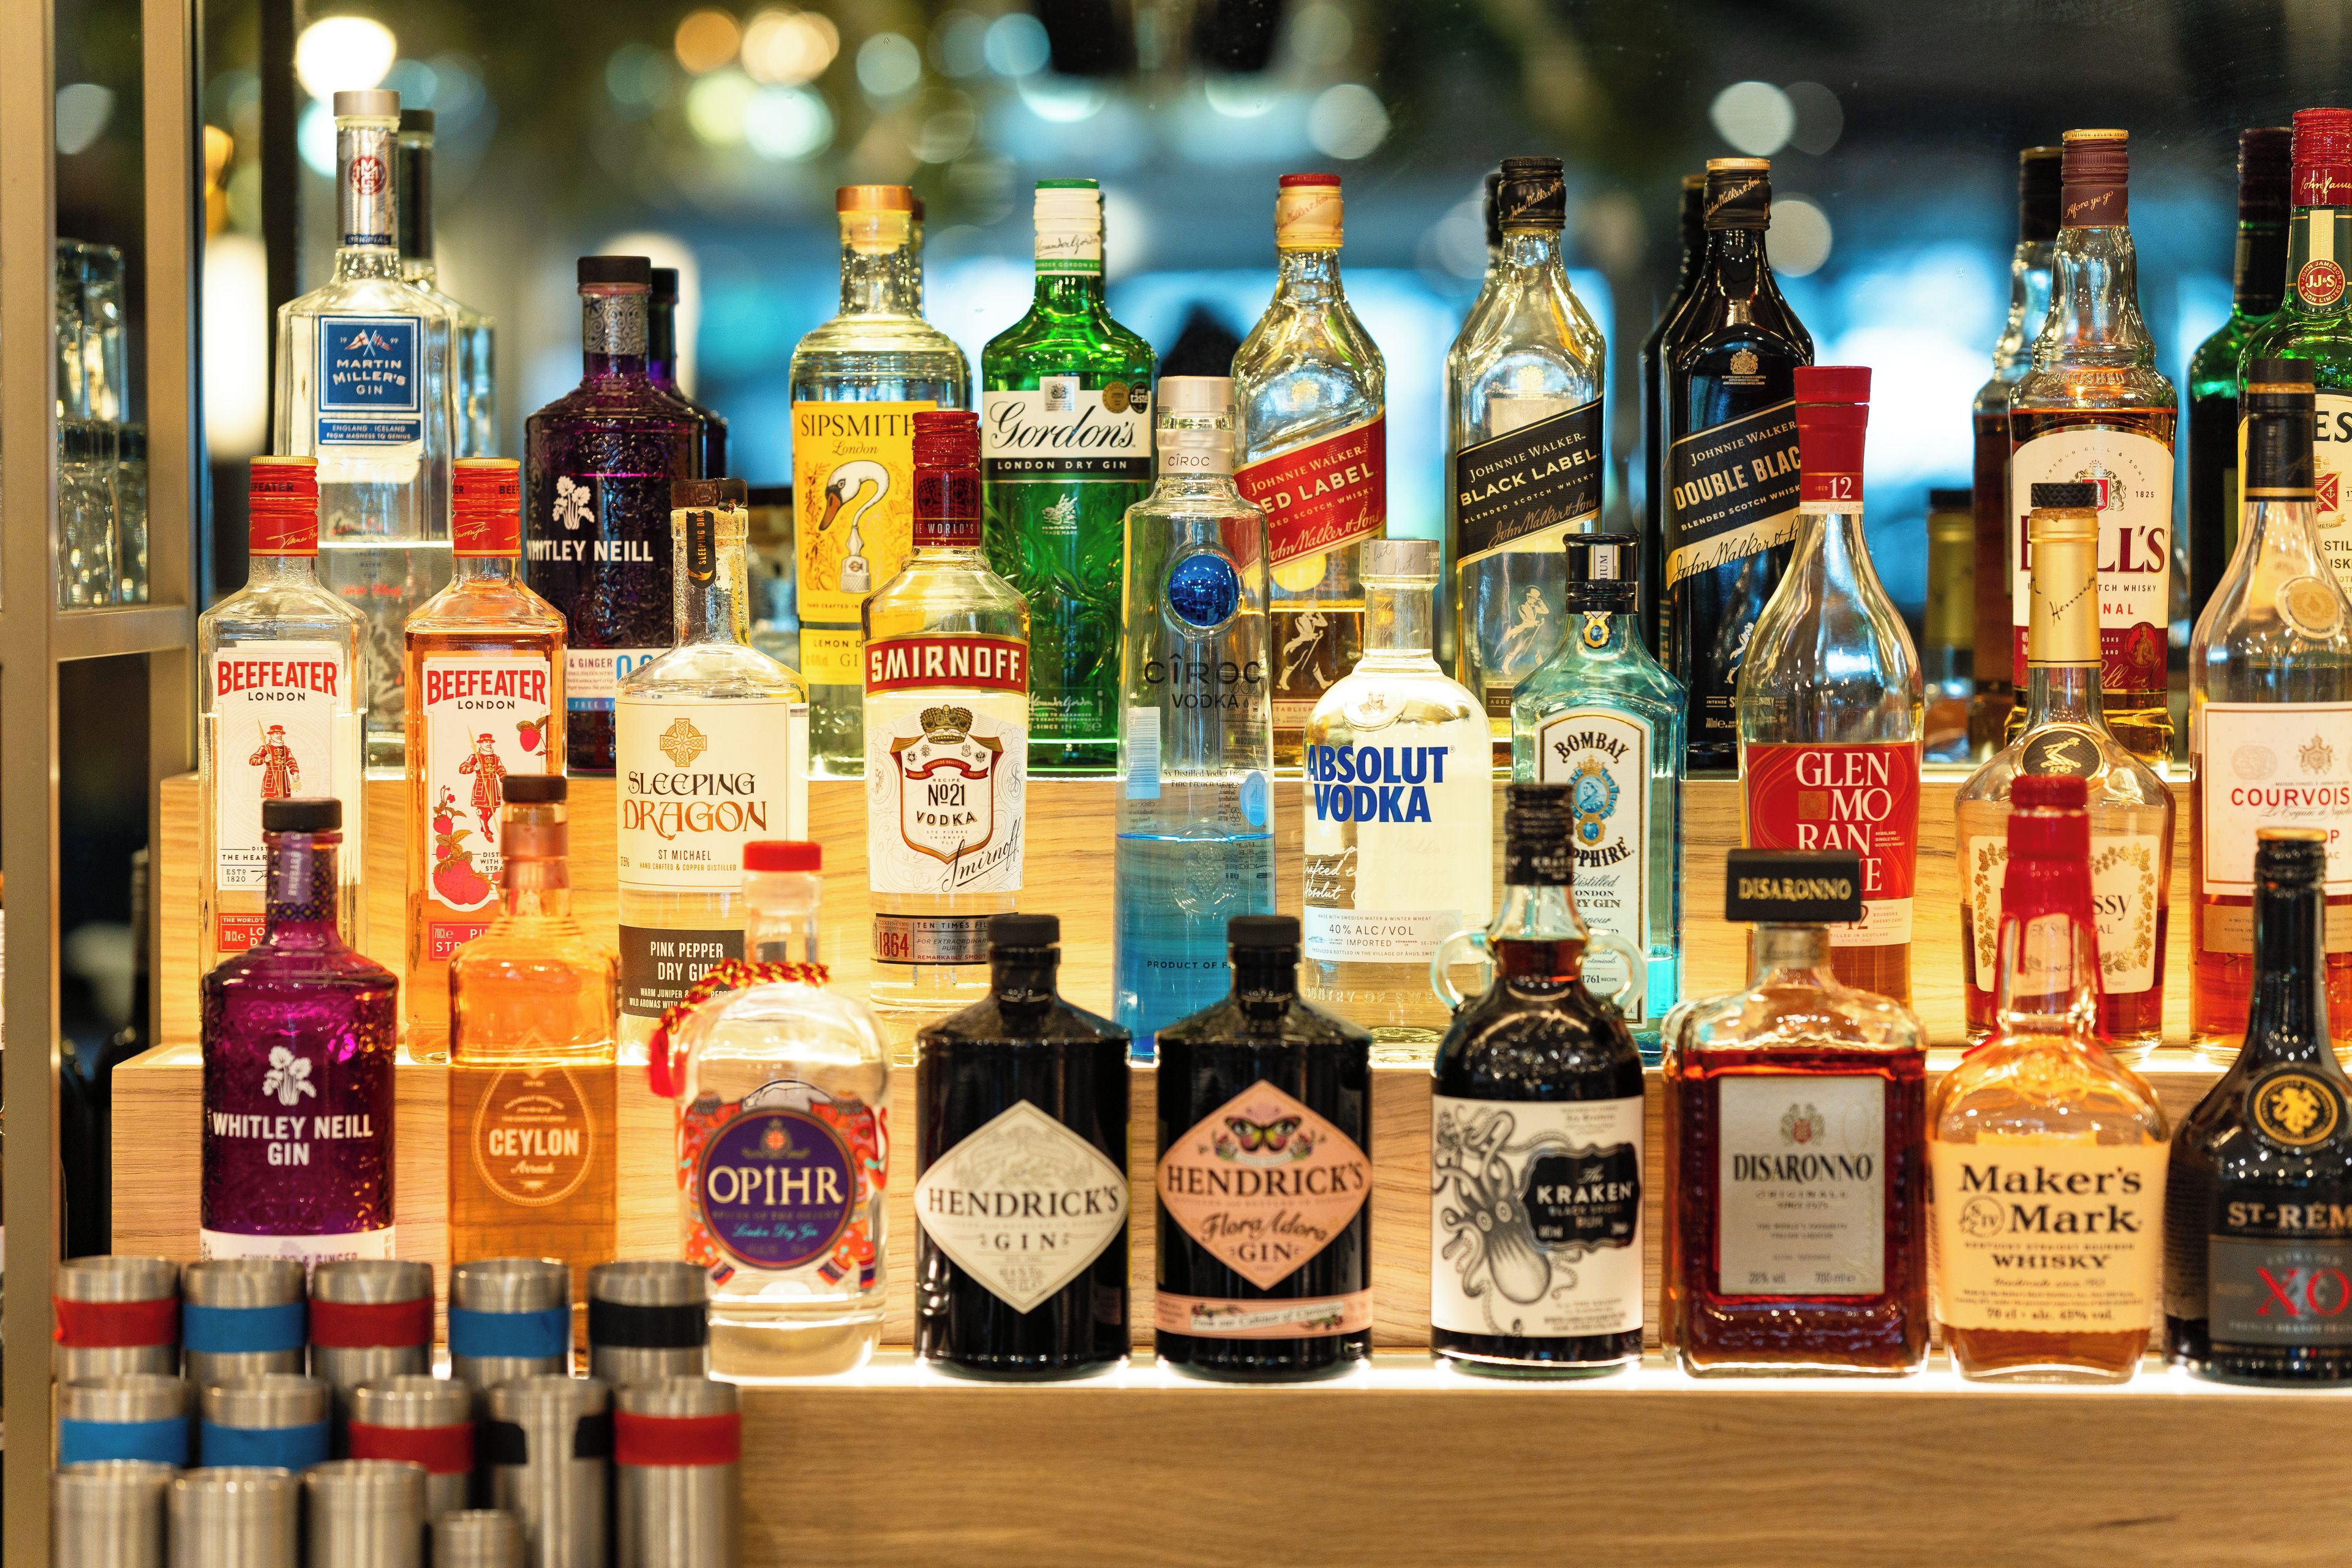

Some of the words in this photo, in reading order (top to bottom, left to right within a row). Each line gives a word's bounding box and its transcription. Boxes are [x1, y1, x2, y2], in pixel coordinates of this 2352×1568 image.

[1717, 186, 1744, 207] Walker
[2300, 176, 2323, 196] John
[2064, 199, 2089, 219] Afore
[2090, 195, 2101, 210] ye
[2103, 190, 2113, 206] go
[2301, 264, 2313, 281] JOHN
[2305, 274, 2335, 288] JJ&S
[2315, 261, 2342, 280] JAMESON
[2304, 292, 2316, 302] SON
[2319, 285, 2342, 303] LIMITED
[337, 359, 402, 369] MARTIN
[333, 371, 406, 386] MILLER'S
[356, 384, 383, 395] GIN
[990, 401, 1135, 449] Gordon's
[832, 439, 880, 456] London
[1690, 437, 1745, 467] JOHNNIE
[1745, 420, 1797, 445] WALKER
[997, 461, 1055, 470] LONDON
[1065, 461, 1093, 469] DRY
[1102, 461, 1127, 469] GIN
[1470, 451, 1526, 483] JOHNNIE
[1528, 432, 1582, 458] WALKER
[2045, 450, 2076, 480] ARTHUR
[2128, 459, 2145, 482] SONS
[1251, 466, 1308, 496] JOHNNIE
[1309, 446, 1363, 470] WALKER
[1298, 462, 1374, 501] LABEL
[1461, 472, 1526, 507] BLACK
[1532, 448, 1597, 481] LABEL
[1673, 464, 1749, 510] DOUBLE
[1752, 445, 1801, 483] BLAC
[1464, 505, 1508, 524] BLENDED
[1513, 488, 1551, 505] SCOTCH
[1558, 472, 1594, 490] WHISKY
[1829, 477, 1852, 499] 12
[1294, 501, 1333, 520] SCOTCH
[1336, 486, 1374, 504] WHISKY
[1681, 510, 1726, 531] BLENDED
[1728, 496, 1767, 514] SCOTCH
[1770, 483, 1801, 499] WHISK
[928, 523, 974, 534] WORLD'S
[1487, 520, 1523, 551] John
[1523, 503, 1564, 533] Walker
[527, 540, 586, 562] WHITLEY
[594, 540, 654, 562] NEILL
[696, 529, 707, 565] SLEEPING
[1672, 551, 1713, 580] John
[1713, 532, 1776, 567] Walker
[578, 658, 612, 668] GINGER
[872, 645, 1021, 683] SMIRNOFF
[1144, 653, 1262, 685] CÎROC
[218, 661, 337, 697] BEEFEATER
[427, 670, 546, 706] BEEFEATER
[248, 692, 306, 701] LONDON
[458, 700, 515, 709] LONDON
[1172, 694, 1240, 709] VODKA
[1553, 731, 1630, 764] BOMBAY
[1307, 744, 1449, 783] ABSOLUT
[1796, 752, 1891, 787] GLEN
[628, 771, 756, 796] SLEEPING
[1314, 783, 1432, 823] VODKA
[1829, 788, 1893, 822] MO
[2231, 787, 2352, 807] COURVOIS
[622, 799, 767, 841] DRAGON
[916, 810, 978, 827] VODKA
[1796, 823, 1872, 856] RAN
[658, 850, 668, 860] ST
[672, 850, 711, 861] MICHAEL
[938, 816, 1021, 893] Smirnoff
[1303, 858, 1341, 879] Crafted
[1304, 878, 1346, 901] Absolut
[1738, 877, 1852, 902] DISARONNO
[1593, 899, 1622, 908] GIN
[1329, 924, 1351, 935] 40%
[1355, 925, 1414, 936] ALC/VOL
[650, 941, 674, 957] PINK
[679, 942, 724, 959] PEPPER
[878, 932, 910, 959] 1864
[1347, 939, 1392, 948] IMPORTED
[657, 961, 684, 981] DRY
[688, 963, 713, 981] GIN
[1147, 960, 1199, 970] PRODUCT
[640, 987, 656, 997] WARM
[657, 989, 683, 998] JUNIPER
[1582, 975, 1600, 984] 1761
[629, 997, 639, 1006] WILD
[639, 999, 661, 1009] AROMAS
[213, 1112, 307, 1140] WHITLEY
[314, 1114, 374, 1140] NEILL
[267, 1142, 311, 1166] GIN
[488, 1127, 580, 1157] CEYLON
[1166, 1162, 1364, 1197] HENDRICK'S
[1733, 1152, 1874, 1185] DISARONNO
[1958, 1164, 2143, 1195] Maker's
[707, 1164, 845, 1206] OPIHR
[1536, 1179, 1633, 1206] KRAKEN
[928, 1186, 1119, 1218] HENDRICK'S
[1200, 1210, 1262, 1243] Flora
[2008, 1203, 2139, 1234] Mark
[994, 1232, 1056, 1251] GIN
[1238, 1243, 1292, 1262] GIN
[1991, 1253, 2109, 1268] WHISKY
[2255, 1267, 2351, 1318] XO
